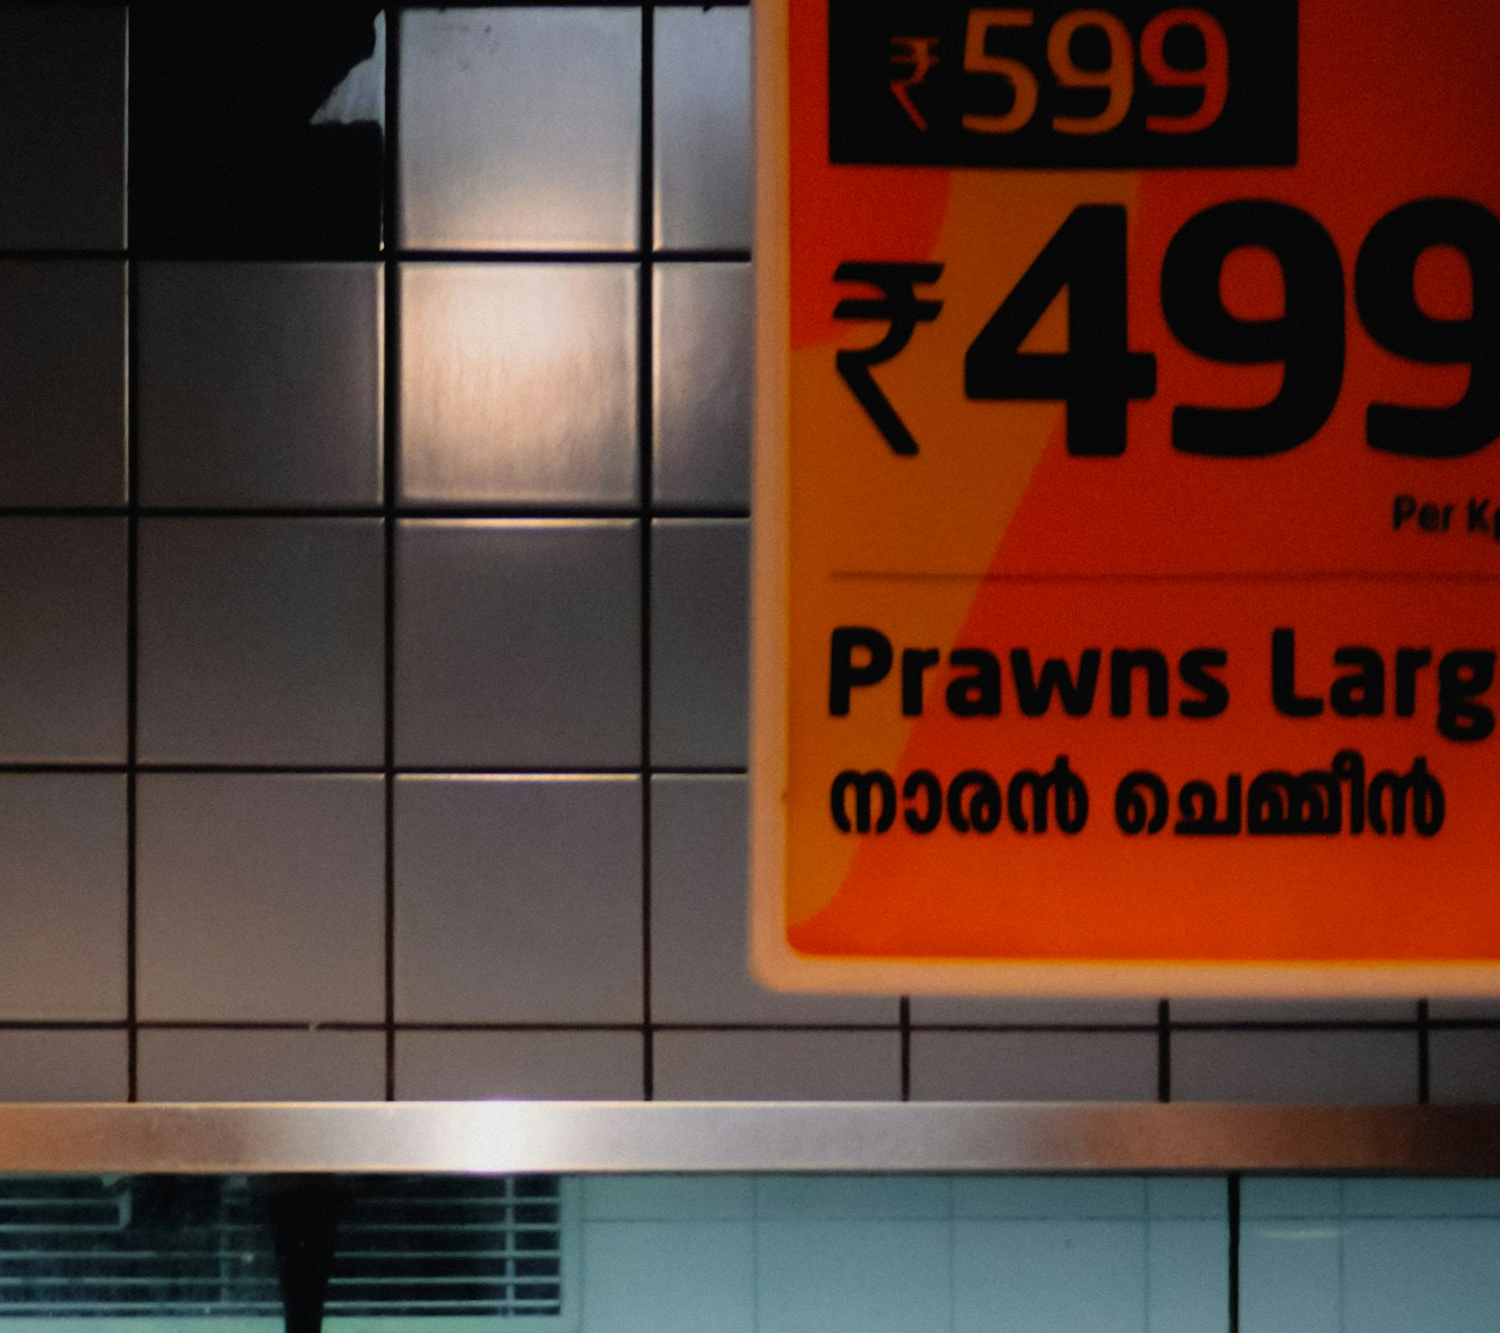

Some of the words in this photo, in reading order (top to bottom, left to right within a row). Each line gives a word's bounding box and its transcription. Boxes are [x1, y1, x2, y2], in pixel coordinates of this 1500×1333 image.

[1393, 495, 1452, 533] Per
[1467, 496, 1500, 541] K
[829, 625, 1229, 719] Prawns
